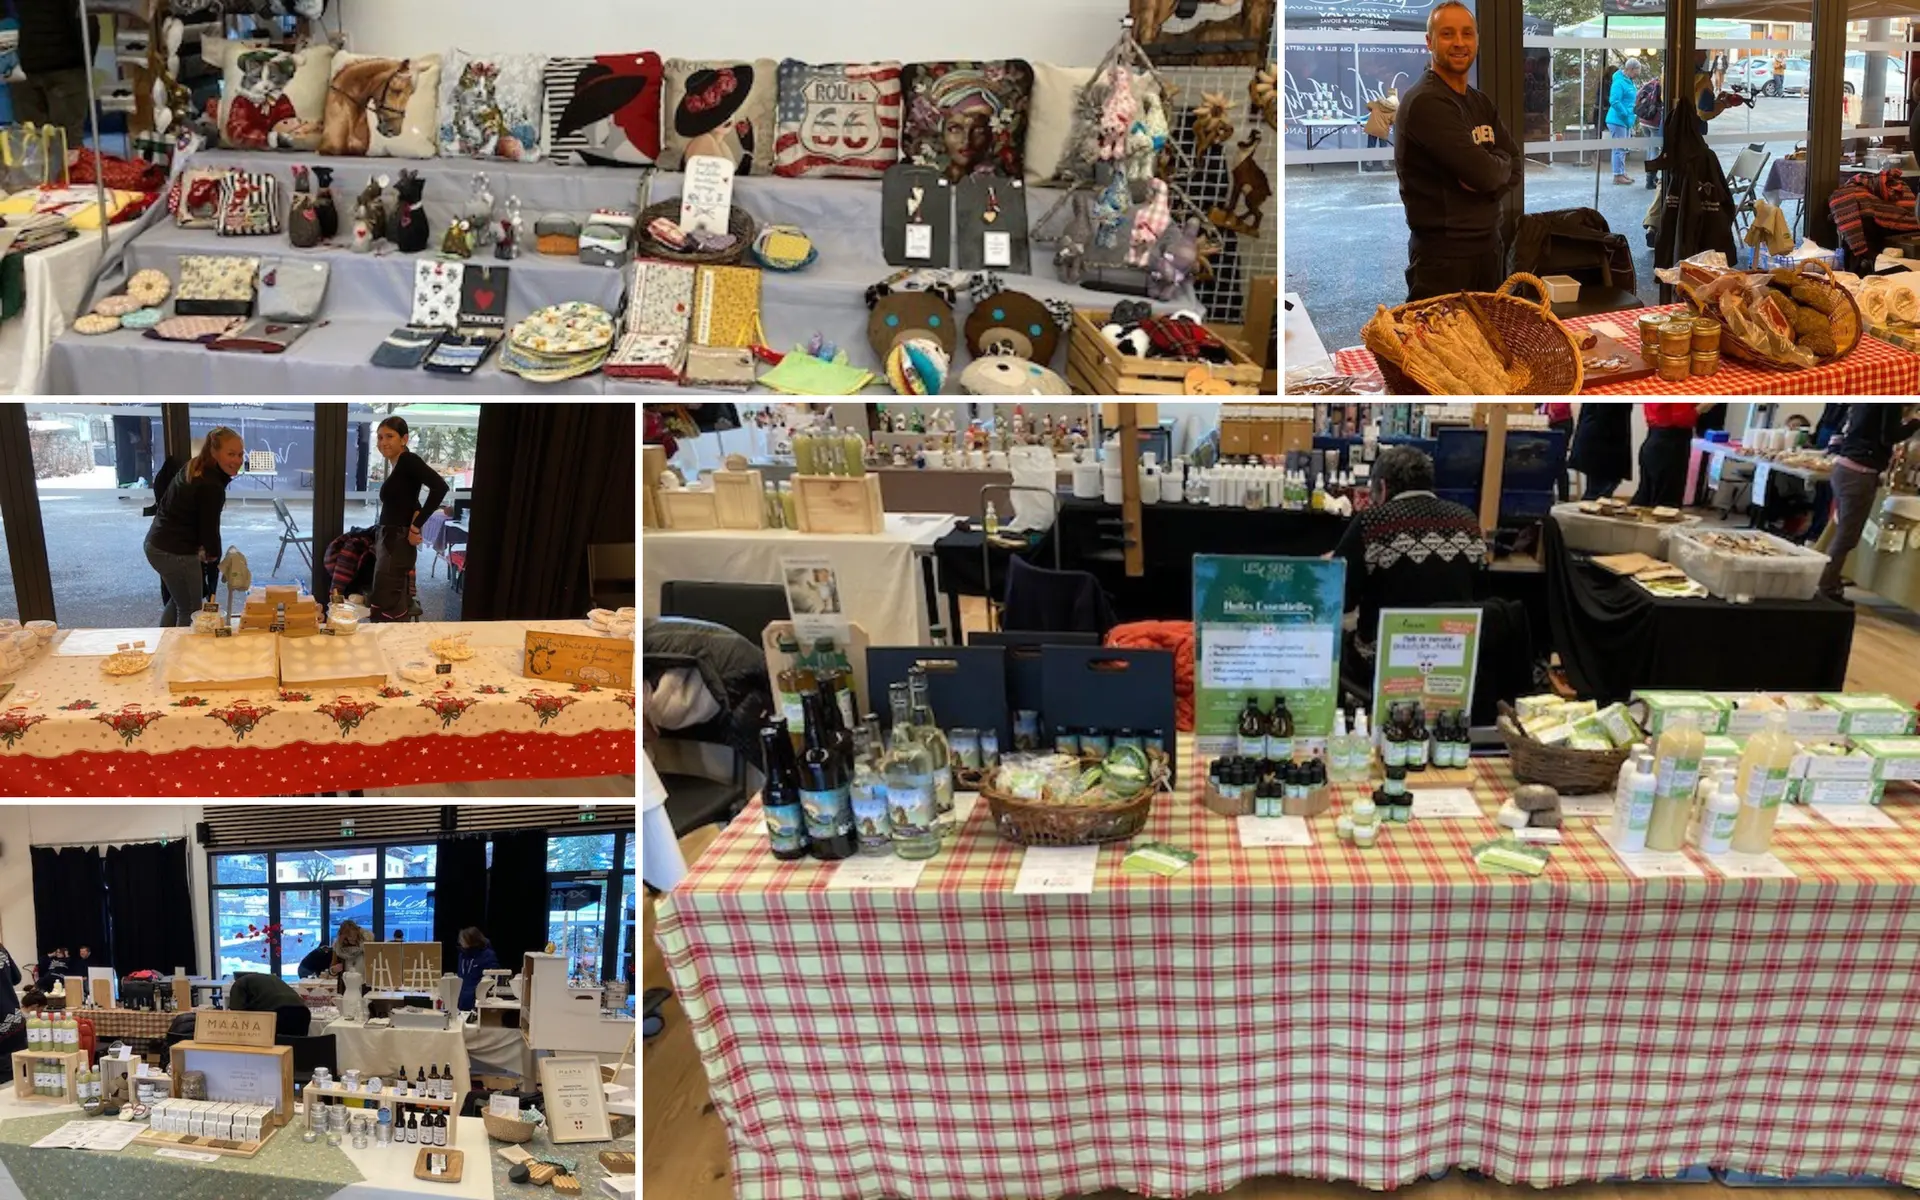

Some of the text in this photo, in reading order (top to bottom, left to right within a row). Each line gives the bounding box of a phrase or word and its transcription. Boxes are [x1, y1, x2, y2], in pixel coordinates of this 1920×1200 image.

[1341, 7, 1419, 15] MONT-BLANC
[1349, 18, 1390, 27] MONT-BLANC
[814, 83, 867, 100] ROUTE
[811, 107, 869, 149] 66
